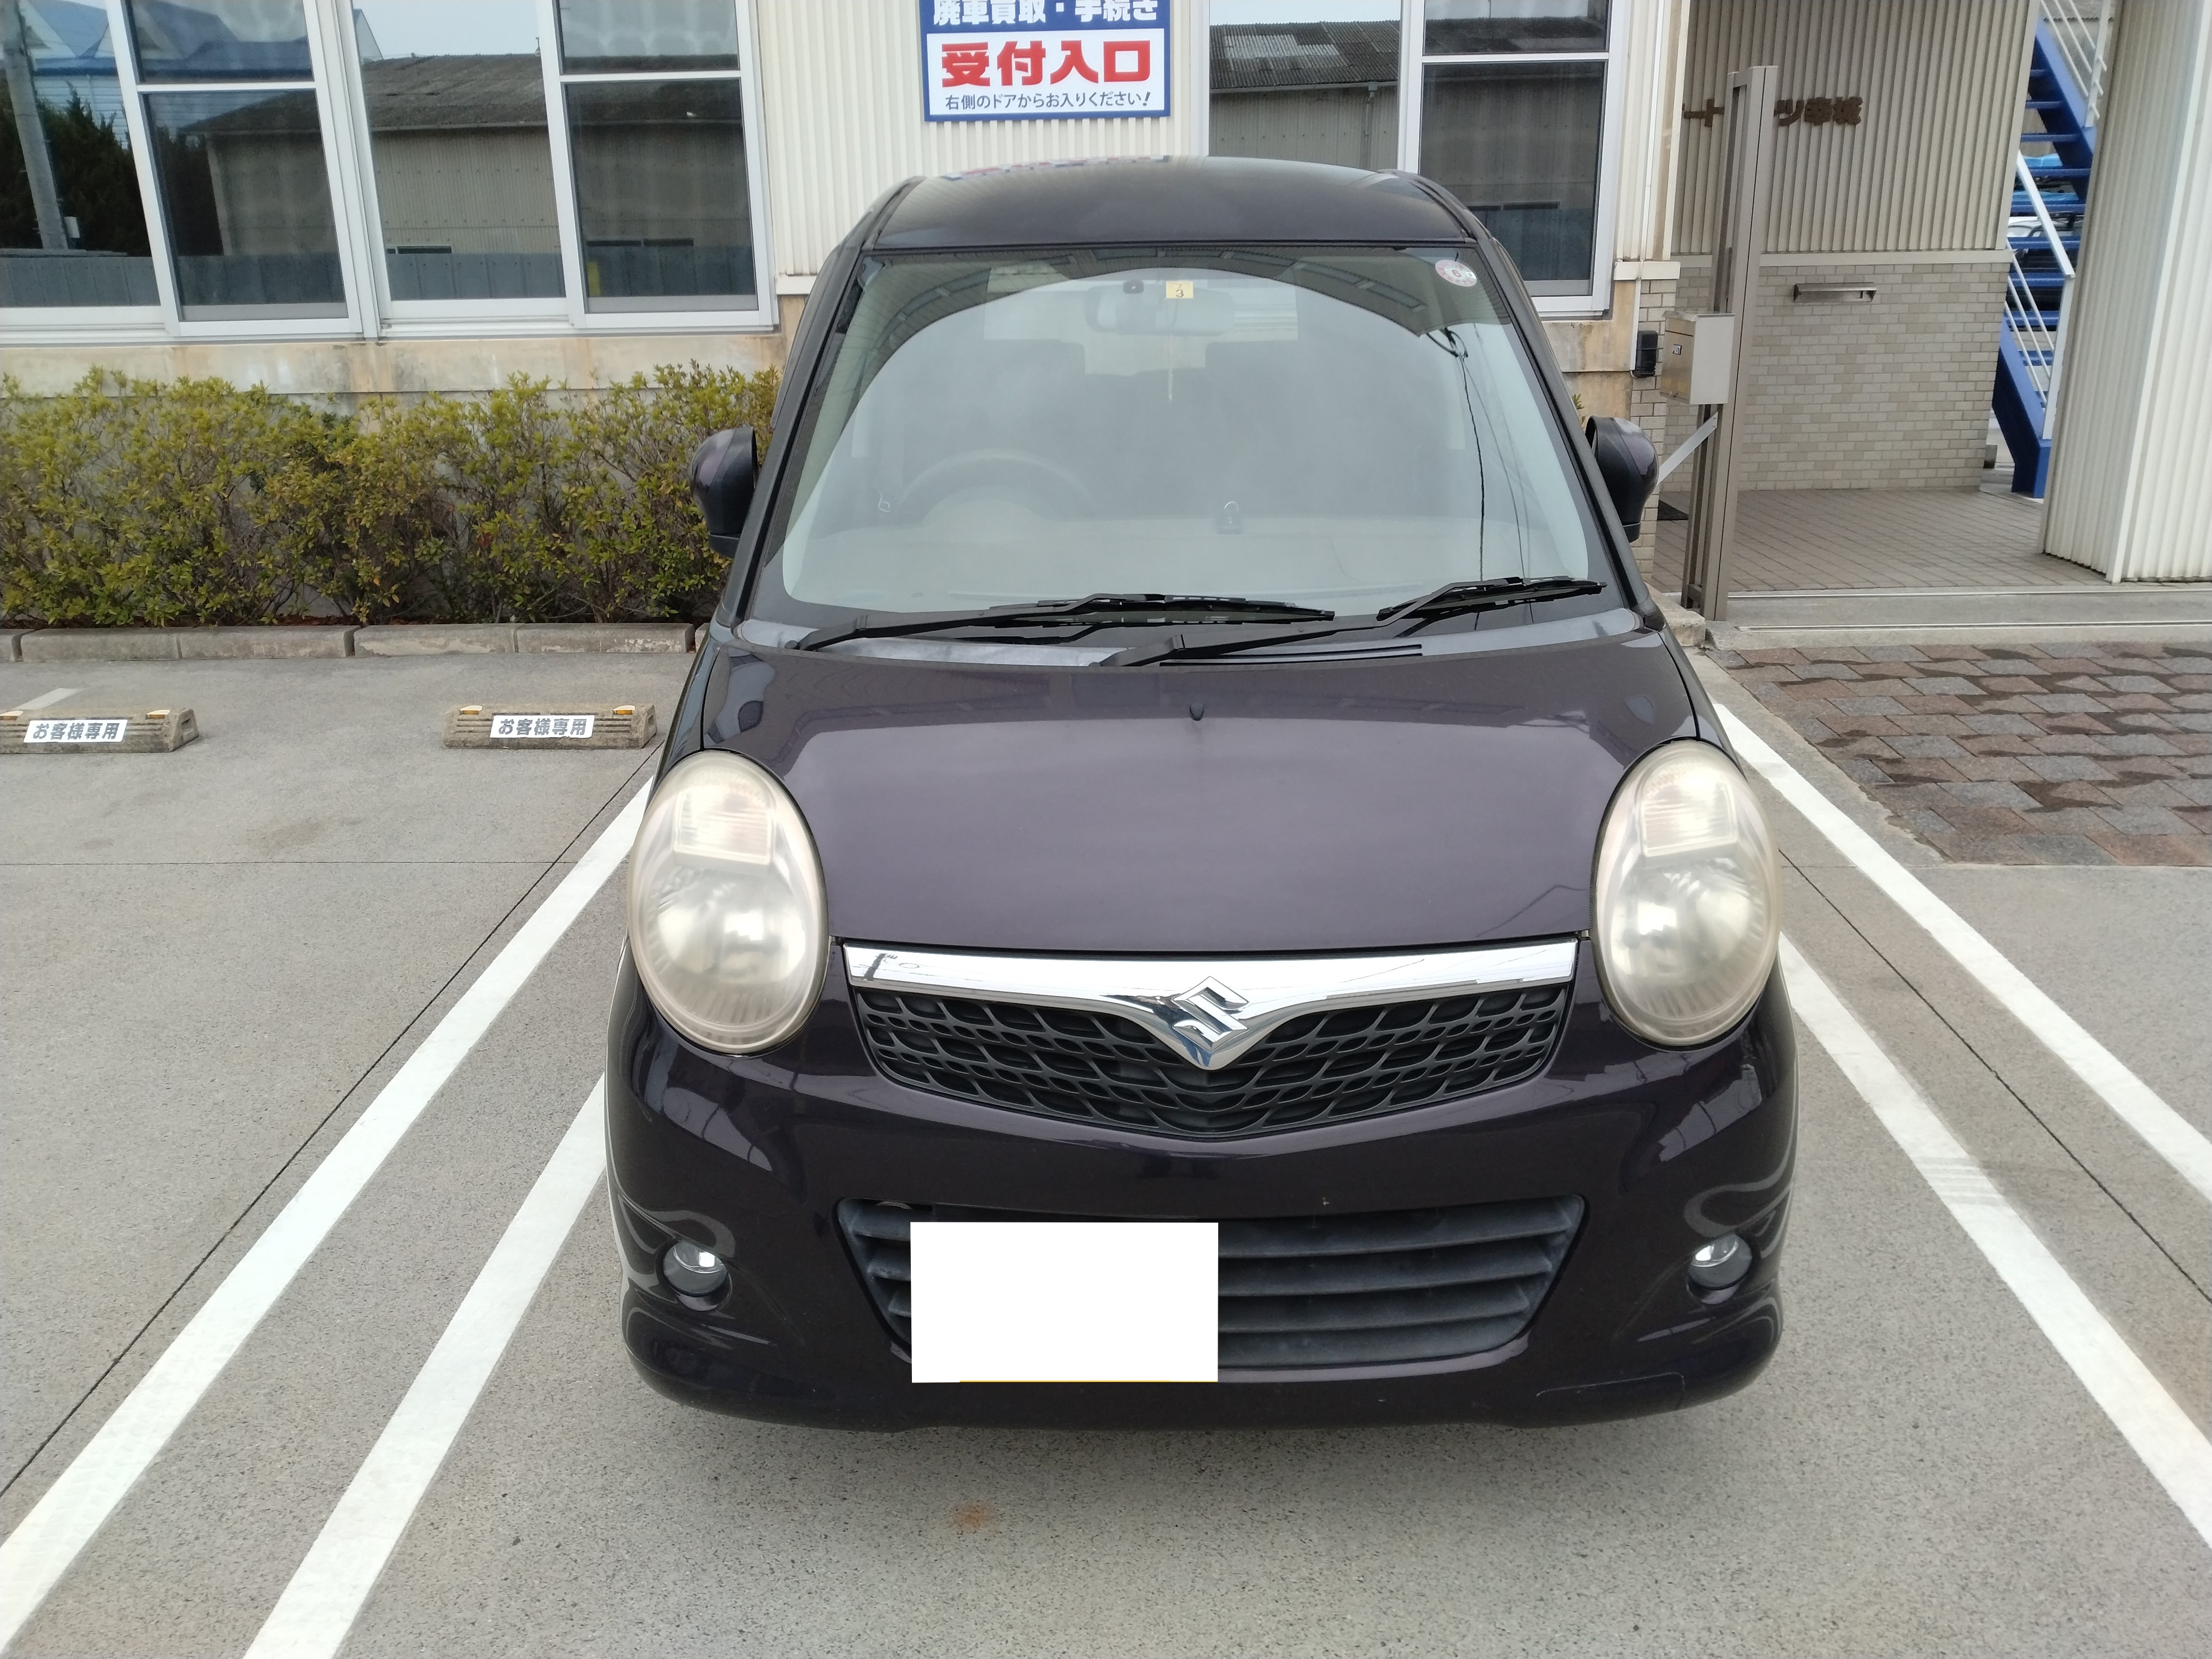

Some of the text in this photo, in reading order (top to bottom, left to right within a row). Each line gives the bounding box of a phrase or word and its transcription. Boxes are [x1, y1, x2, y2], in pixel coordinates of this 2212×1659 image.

[942, 40, 1151, 88] 受付入口
[945, 91, 1151, 110] 右側のドアからお入りください!
[1176, 289, 1184, 298] 3
[32, 723, 120, 740] お客様専用
[498, 718, 588, 736] お客様専用
